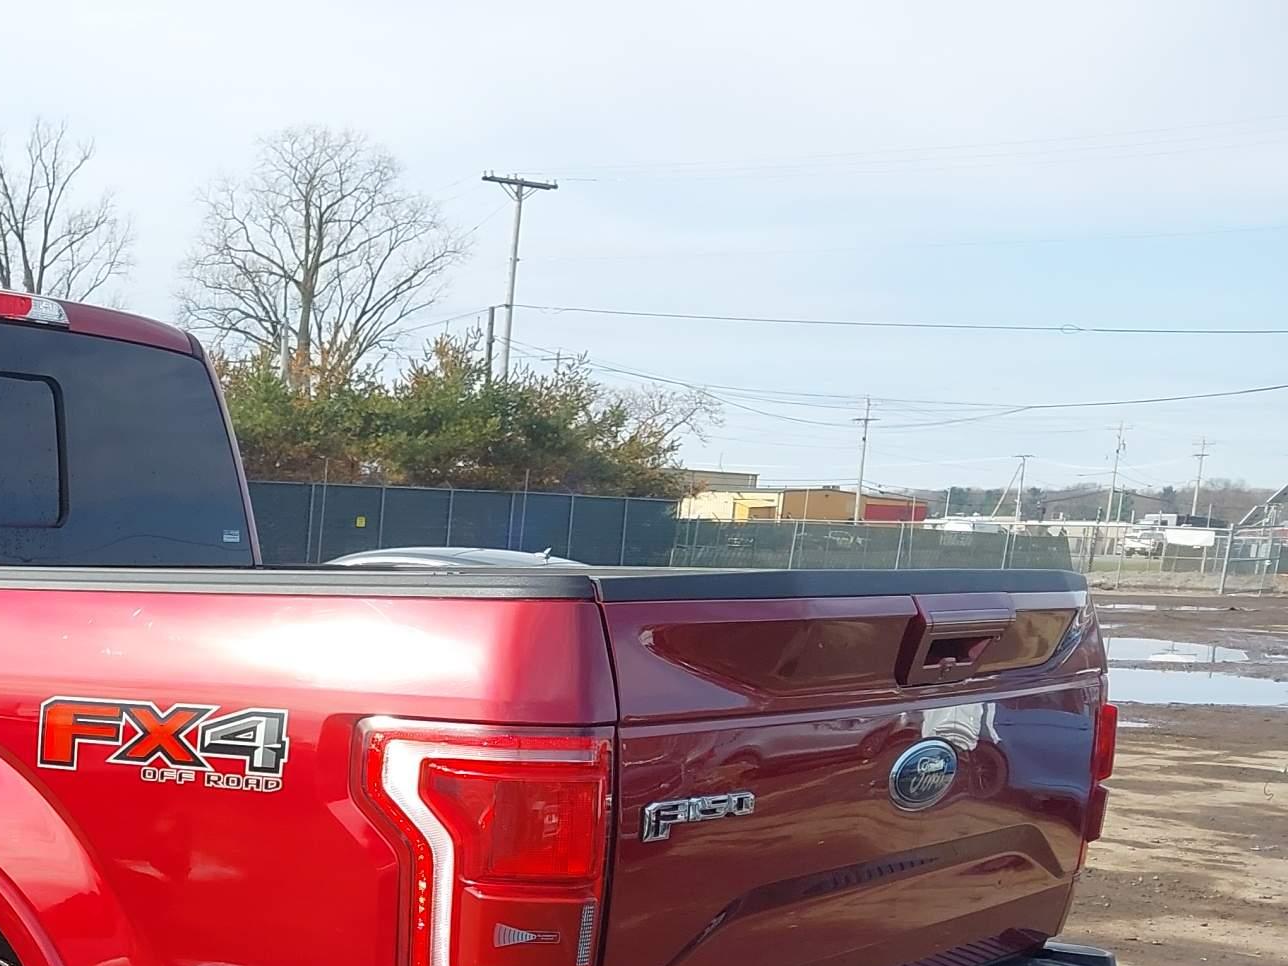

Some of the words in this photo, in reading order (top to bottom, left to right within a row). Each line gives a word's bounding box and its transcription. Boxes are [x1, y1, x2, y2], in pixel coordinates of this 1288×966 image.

[37, 695, 289, 777] FX4
[141, 767, 195, 784] OFF
[204, 772, 283, 792] ROAD
